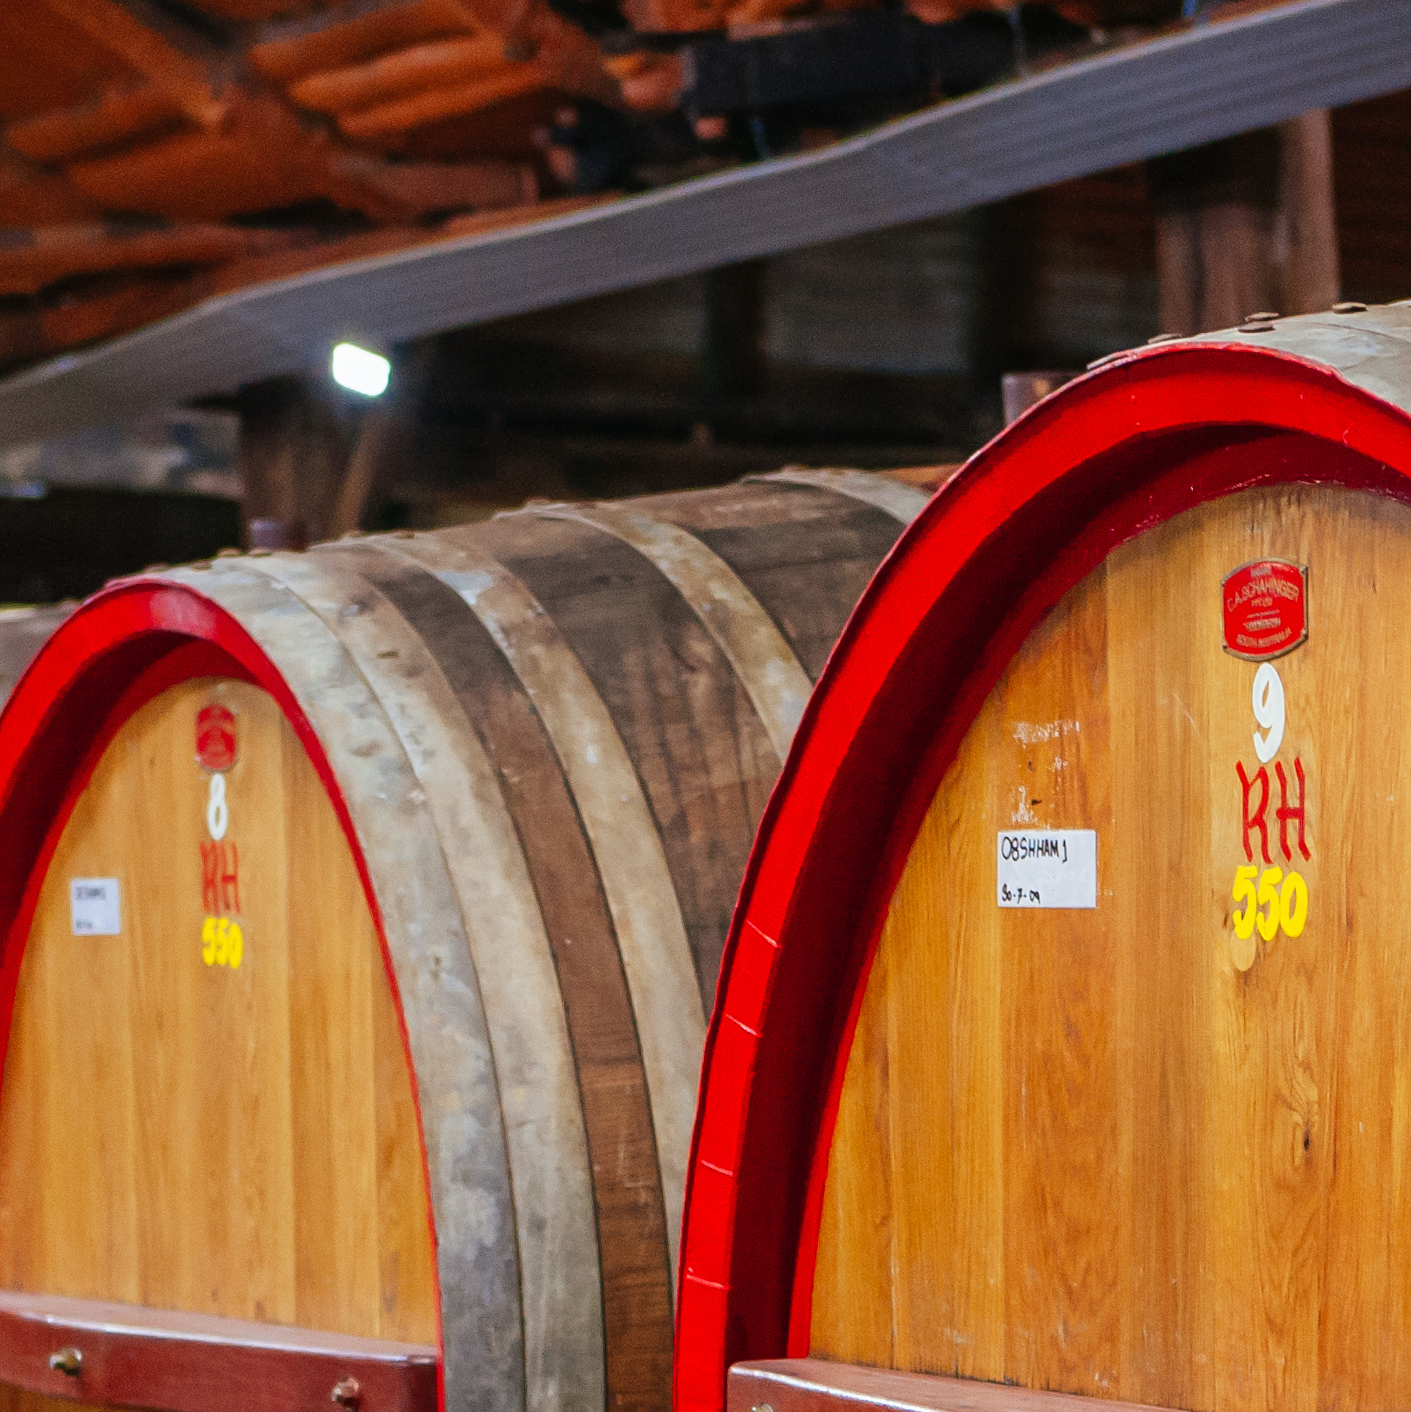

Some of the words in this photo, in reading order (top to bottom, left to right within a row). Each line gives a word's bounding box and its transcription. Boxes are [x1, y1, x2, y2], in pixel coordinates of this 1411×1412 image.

[1252, 662, 1285, 763] 9
[206, 772, 229, 841] 8
[1235, 757, 1312, 864] RH
[1232, 864, 1309, 941] 550
[201, 916, 244, 970] 550
